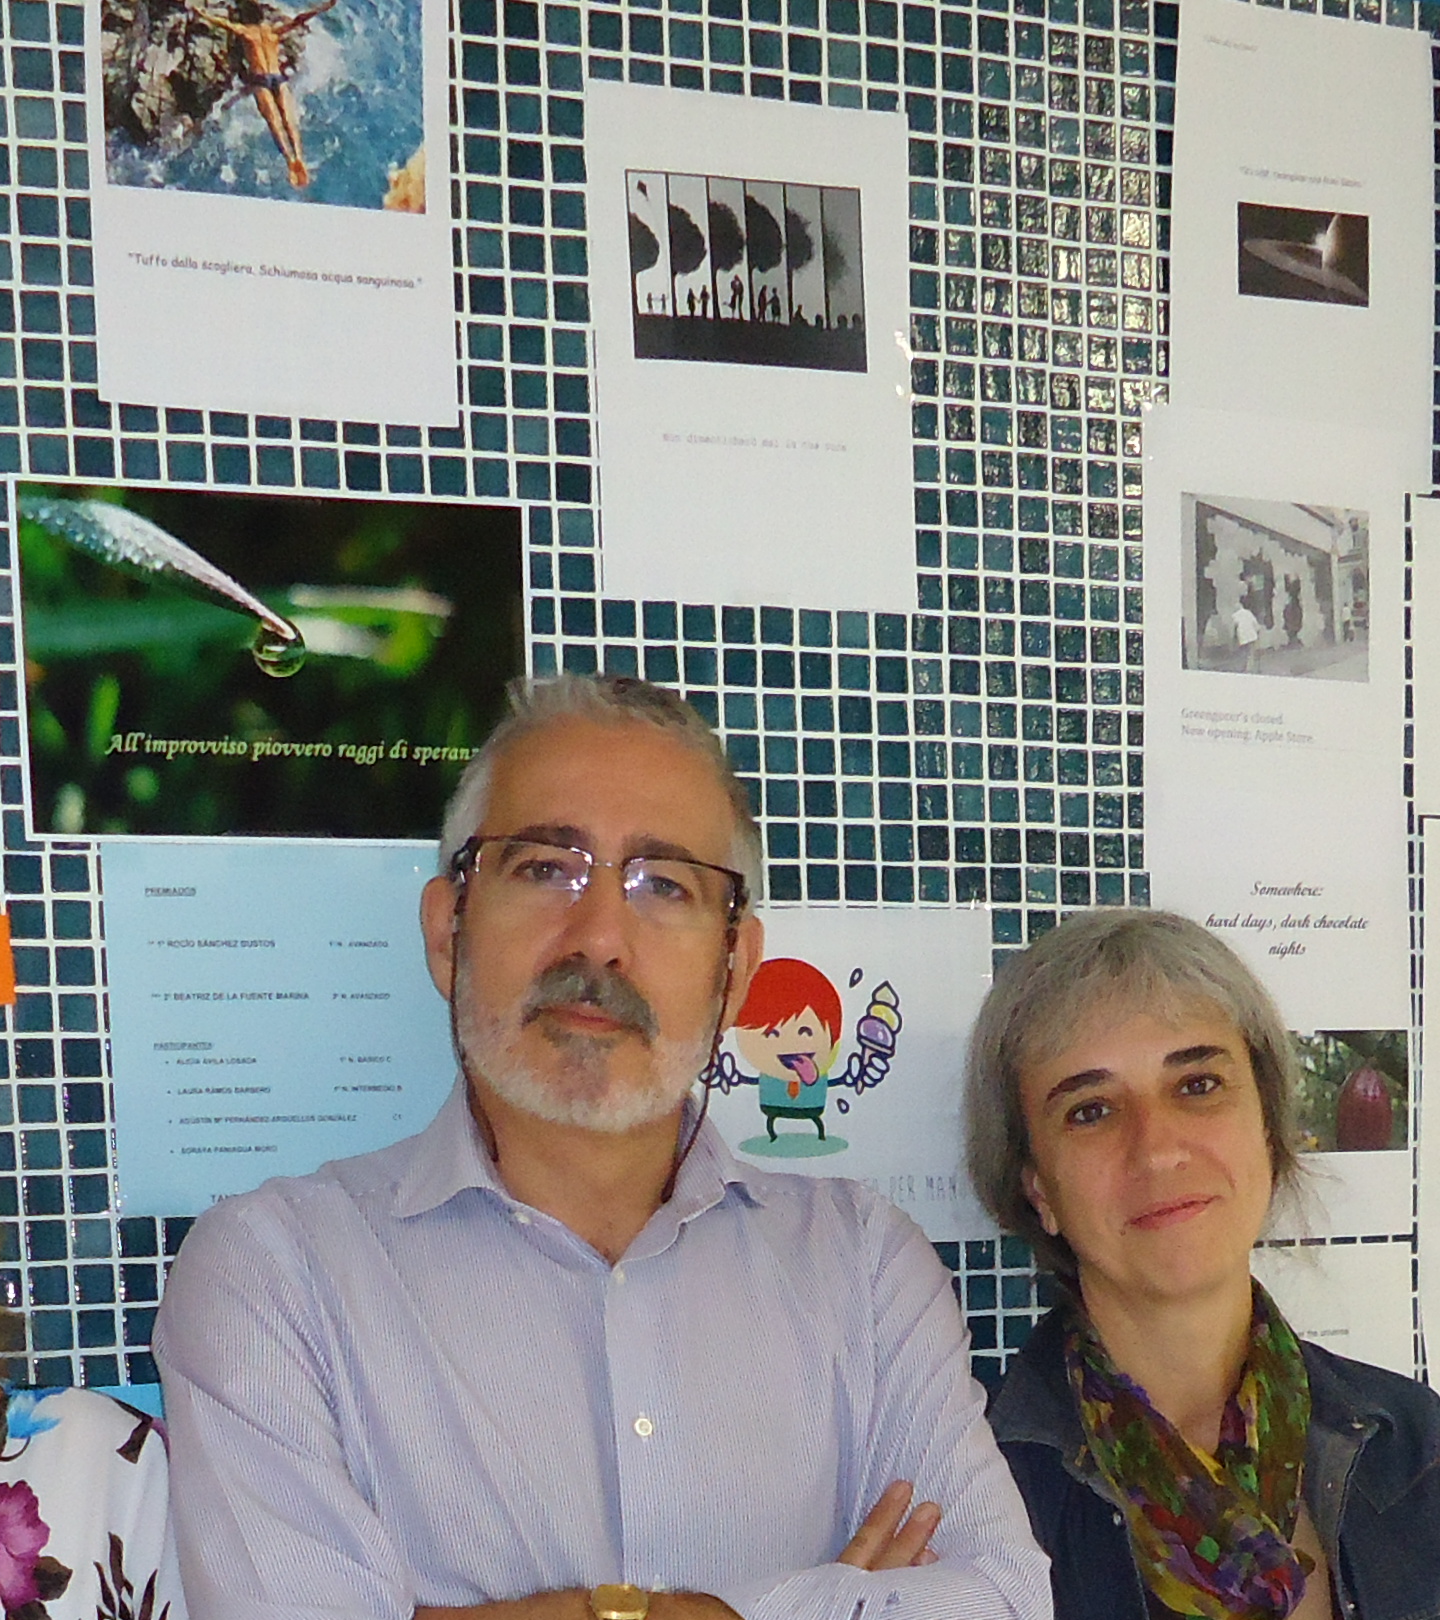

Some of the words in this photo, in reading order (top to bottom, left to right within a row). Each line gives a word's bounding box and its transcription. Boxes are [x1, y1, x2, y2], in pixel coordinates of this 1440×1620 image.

[322, 270, 353, 285] acqua
[107, 731, 248, 761] All'improvviso
[253, 737, 333, 764] piovvero
[339, 741, 386, 765] raggi
[389, 738, 409, 760] di
[1249, 880, 1324, 897] Somewhere:
[1205, 913, 1239, 929] hard
[1241, 914, 1277, 933] days,
[1280, 913, 1310, 929] dark
[1313, 914, 1369, 931] chocolate
[1268, 941, 1306, 959] nights
